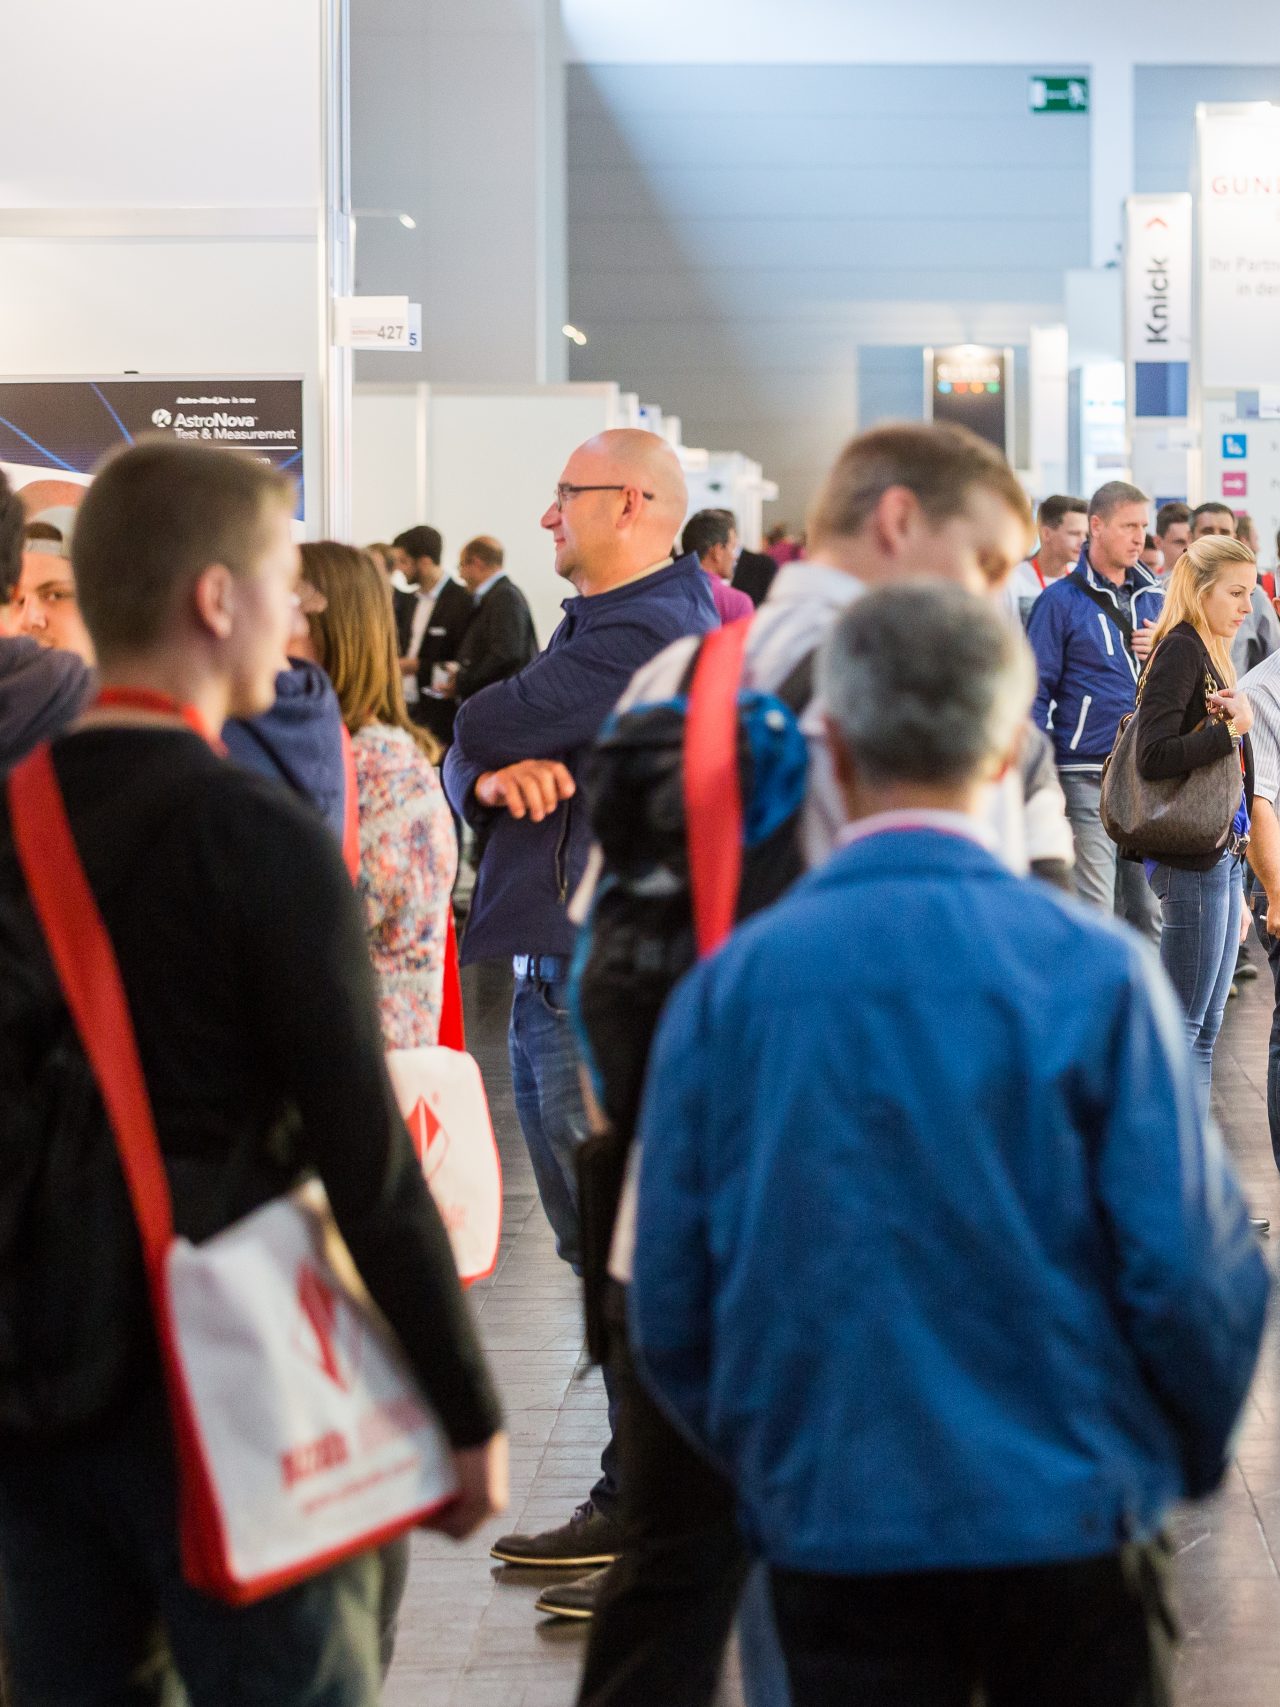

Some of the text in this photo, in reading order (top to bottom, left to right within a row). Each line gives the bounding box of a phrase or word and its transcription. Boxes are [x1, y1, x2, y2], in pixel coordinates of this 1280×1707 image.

[1146, 257, 1169, 343] Knick
[377, 326, 404, 340] 427
[174, 427, 297, 440] Test & Measurement
